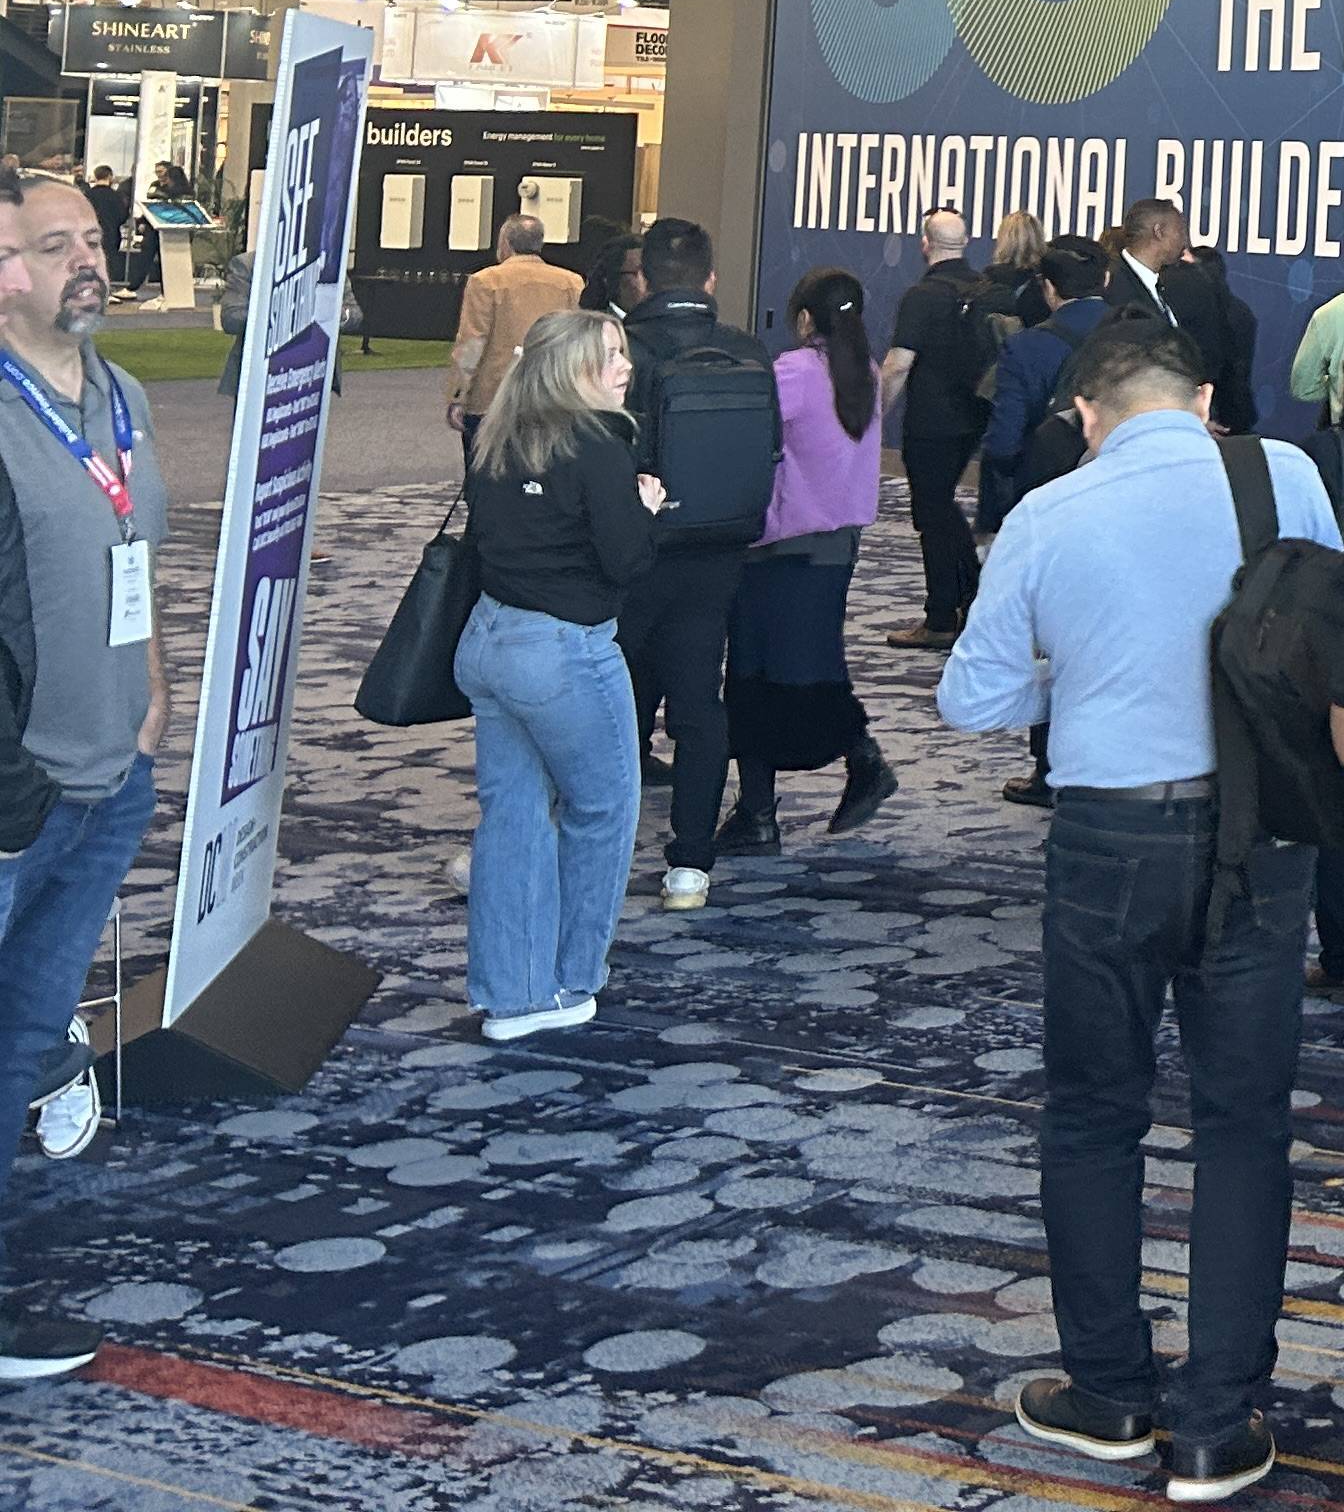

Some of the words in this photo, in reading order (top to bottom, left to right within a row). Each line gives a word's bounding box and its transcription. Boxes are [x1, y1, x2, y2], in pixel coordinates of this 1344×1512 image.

[108, 43, 170, 55] STAINLESS
[636, 44, 668, 56] DECO
[367, 121, 452, 147] builders
[274, 117, 321, 284] SEE
